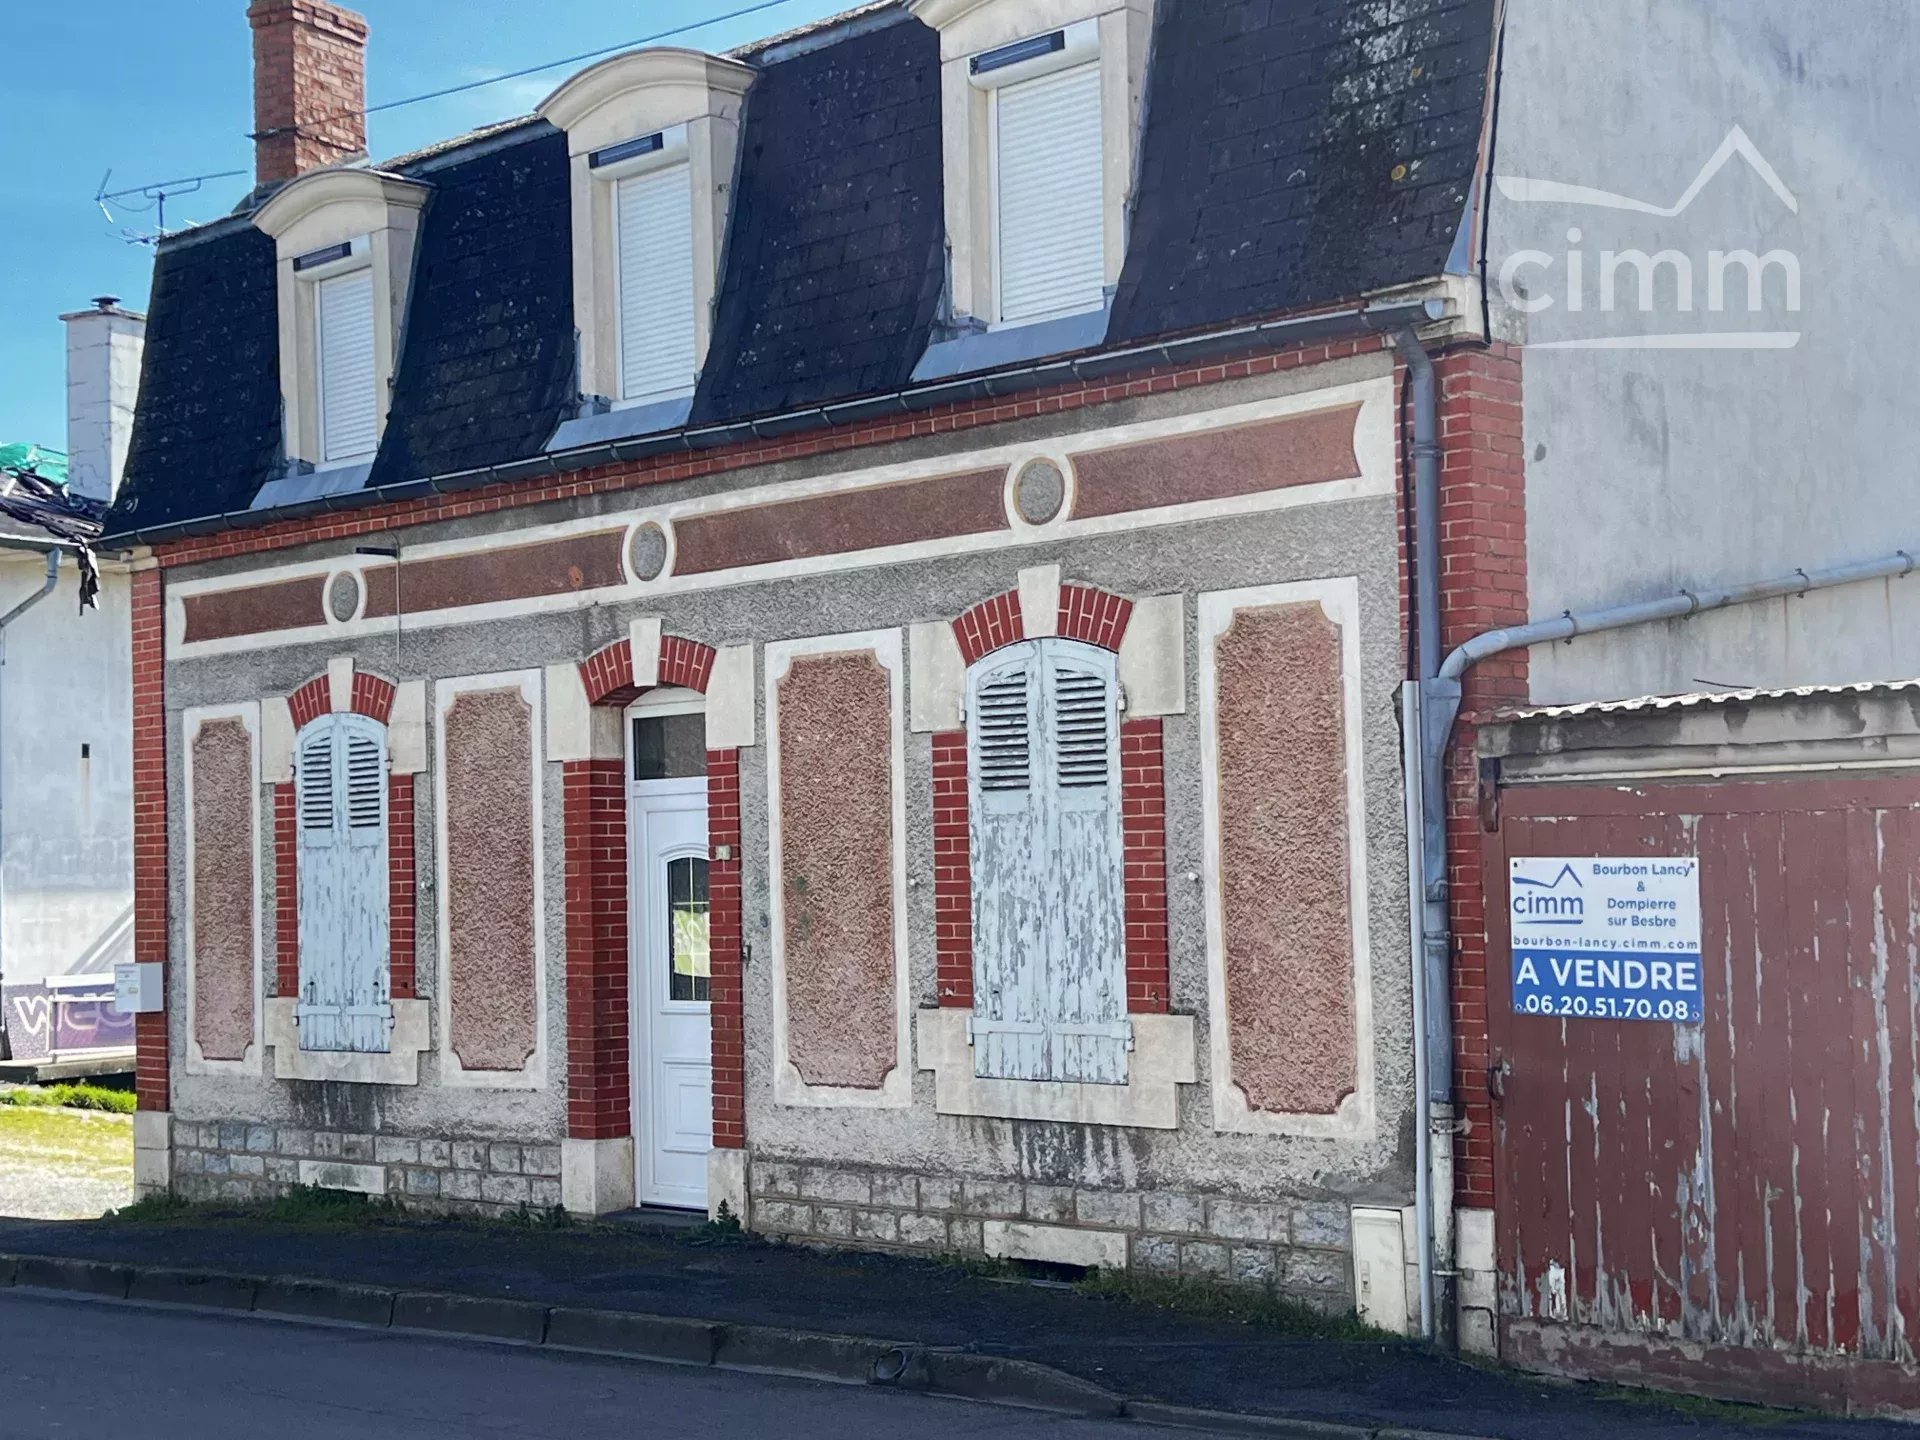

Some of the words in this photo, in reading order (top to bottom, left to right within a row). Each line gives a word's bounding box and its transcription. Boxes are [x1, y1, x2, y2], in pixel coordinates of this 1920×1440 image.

[1592, 864, 1648, 875] Bourbon
[1652, 864, 1690, 877] Lancy
[1636, 880, 1646, 892] &
[1513, 890, 1583, 914] cimm
[1607, 898, 1676, 911] Dompierre
[1607, 917, 1627, 926] sur
[1631, 915, 1676, 927] Besbre
[1513, 936, 1698, 949] bourbon-lancy.cimm.com
[1516, 957, 1540, 986] A
[1549, 958, 1697, 991] VENDRE
